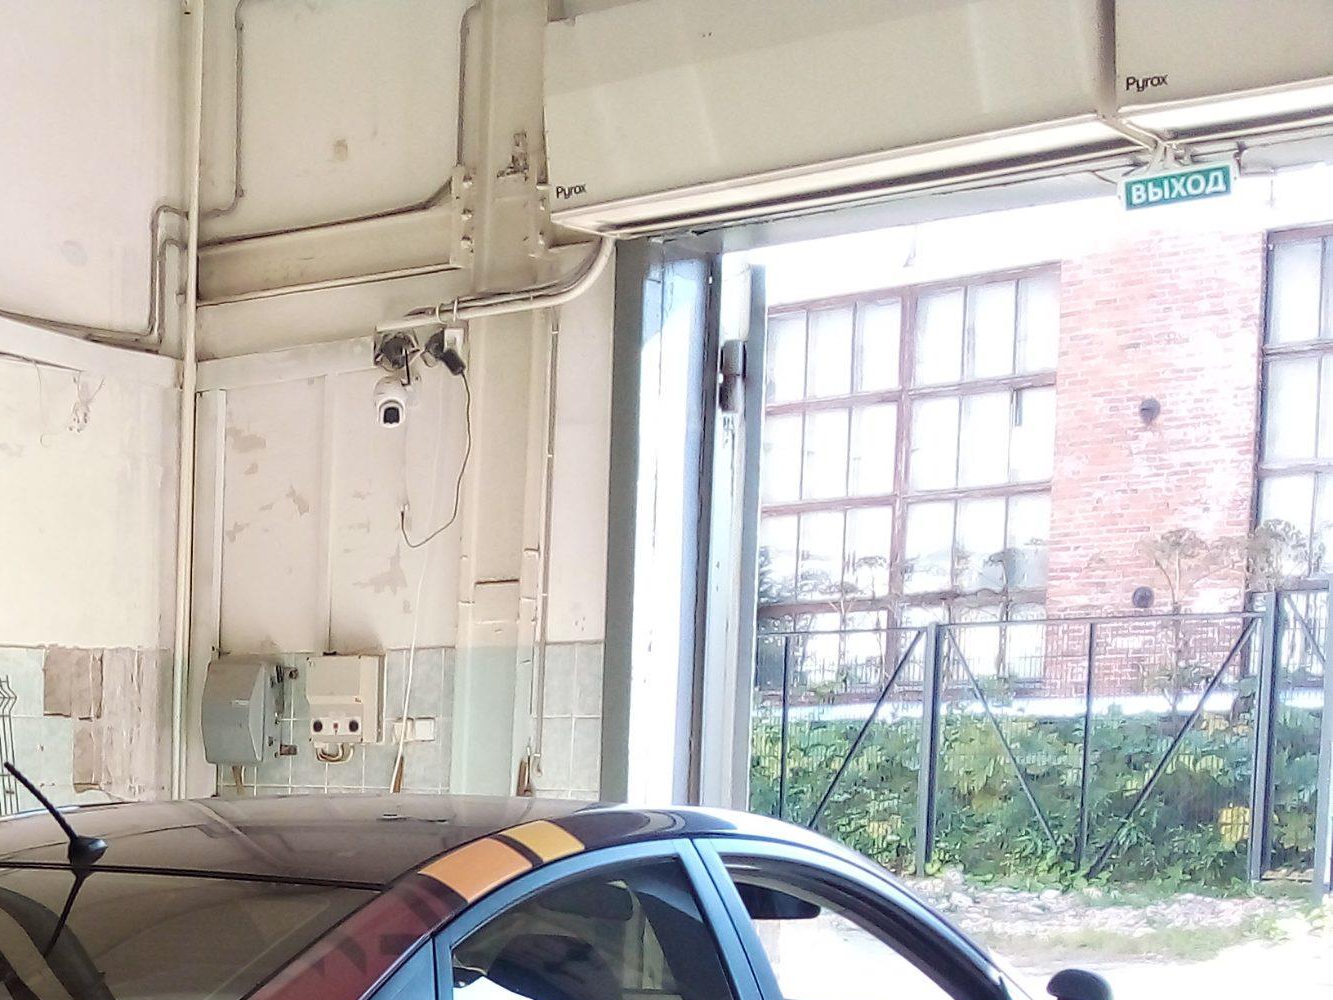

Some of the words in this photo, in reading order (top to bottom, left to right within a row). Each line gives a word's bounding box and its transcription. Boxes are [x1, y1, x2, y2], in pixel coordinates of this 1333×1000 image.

[1125, 74, 1169, 92] Pyrox
[555, 184, 587, 199] Pyrox
[1130, 169, 1228, 206] ВЫХОД
